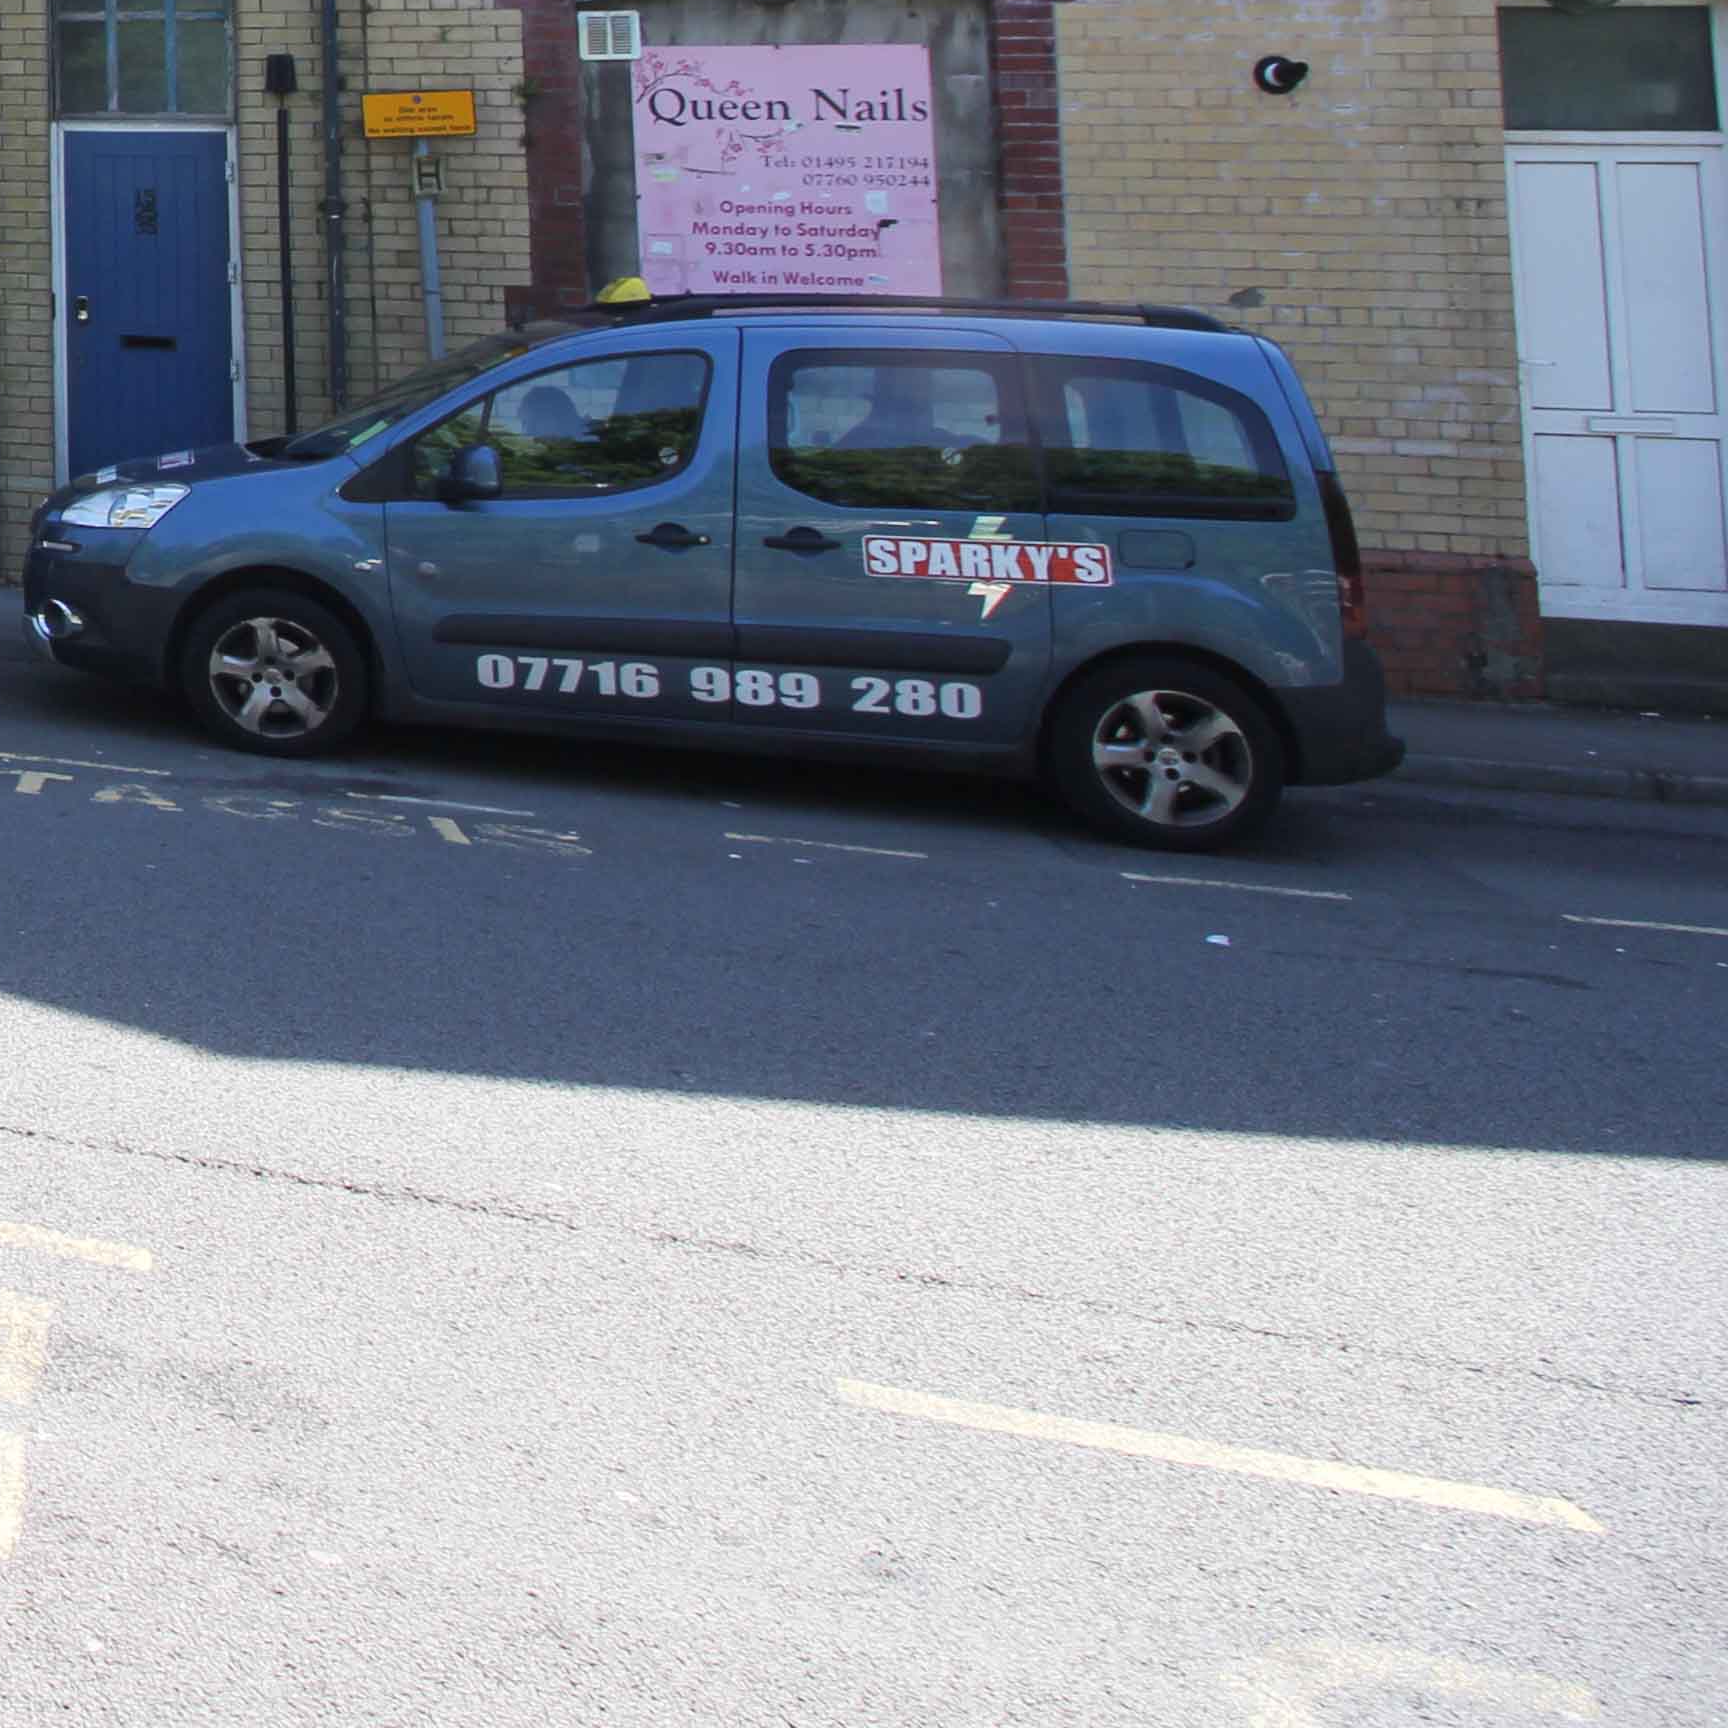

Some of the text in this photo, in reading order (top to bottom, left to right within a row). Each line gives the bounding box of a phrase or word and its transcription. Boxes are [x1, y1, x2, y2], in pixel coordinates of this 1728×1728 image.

[648, 87, 929, 127] Queen Nails
[760, 154, 930, 170] Tel: 01495 217194
[802, 173, 931, 187] 07760 950244
[719, 200, 853, 217] Opening Hours
[691, 222, 881, 241] Monday to Saturday
[704, 241, 878, 260] 9.30am to 5.30pm
[712, 270, 865, 286] Walk in Welcome
[868, 538, 1107, 583] SPARKY'S
[476, 652, 983, 719] 07716 989 280
